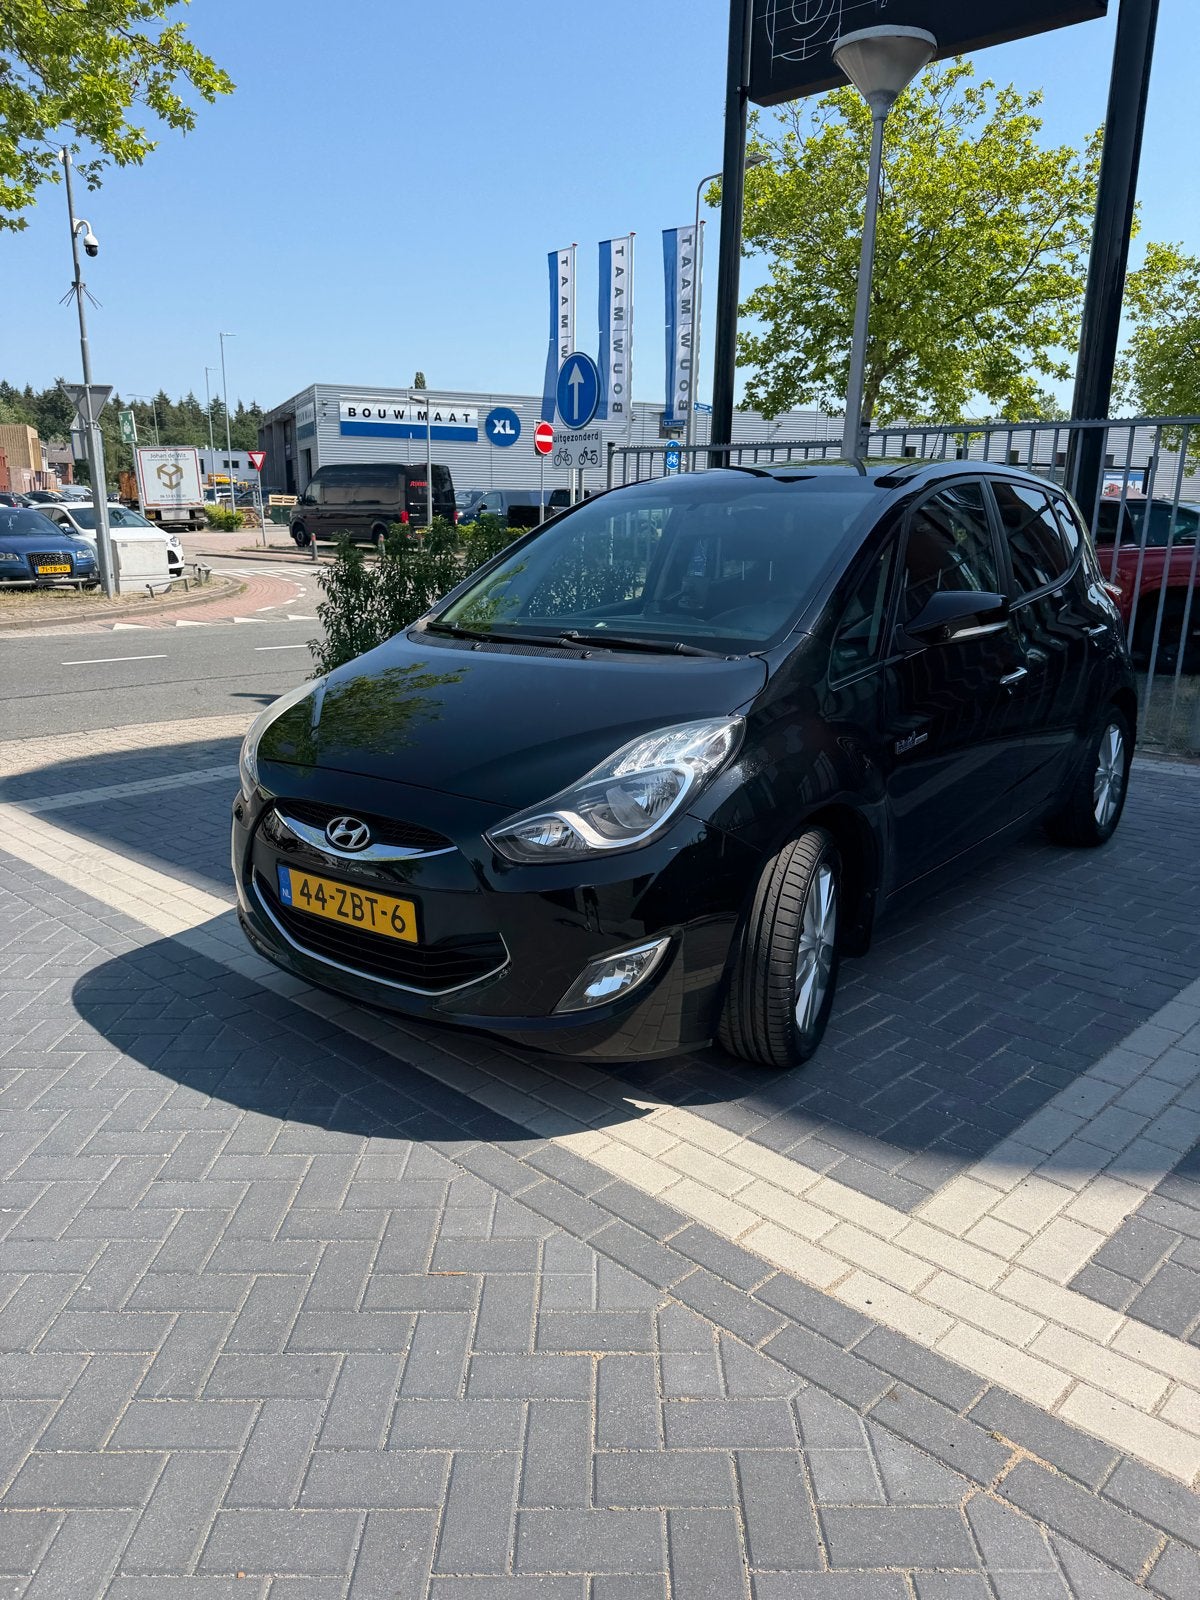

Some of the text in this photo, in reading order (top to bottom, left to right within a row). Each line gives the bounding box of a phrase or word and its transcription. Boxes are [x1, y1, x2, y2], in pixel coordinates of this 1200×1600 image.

[348, 407, 470, 423] BOUW MAAT
[493, 419, 515, 434] XL
[553, 432, 599, 444] uitgezonderd
[282, 887, 291, 898] NL
[300, 878, 406, 934] 44-ZBT-6
